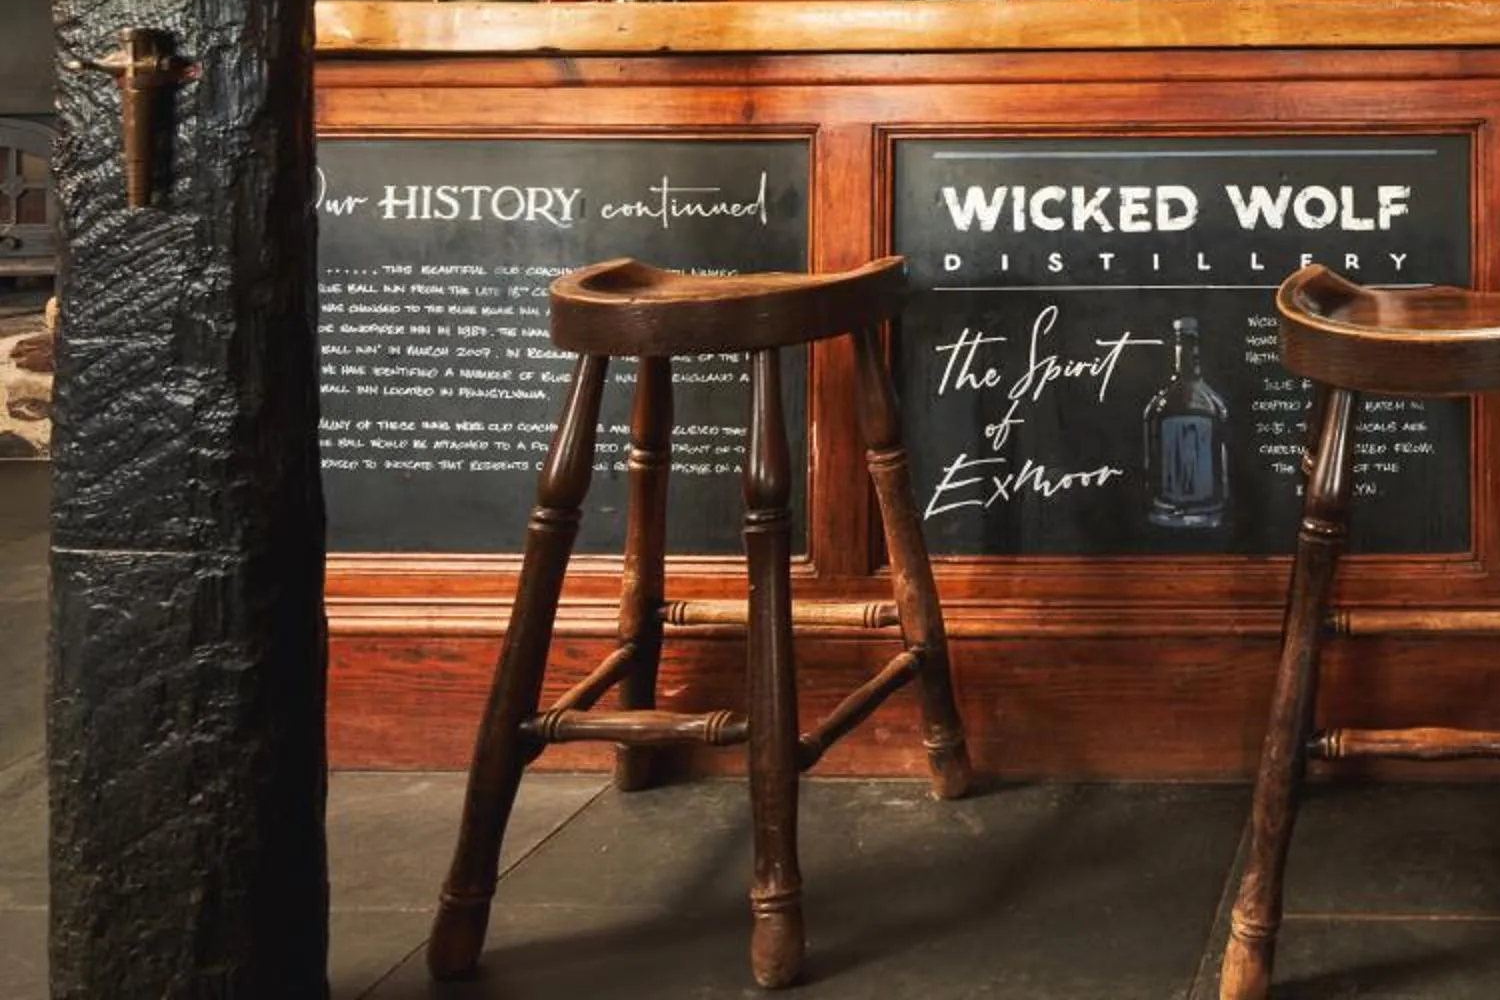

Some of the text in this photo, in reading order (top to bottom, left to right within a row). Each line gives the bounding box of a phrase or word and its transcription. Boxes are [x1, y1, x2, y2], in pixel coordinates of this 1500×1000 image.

[316, 166, 768, 229] ur HISTORY continued
[941, 184, 1413, 233] WICKED WOLF
[944, 251, 1408, 272] DISTILLERY
[935, 304, 1164, 402] the Spirit
[985, 400, 1025, 450] of
